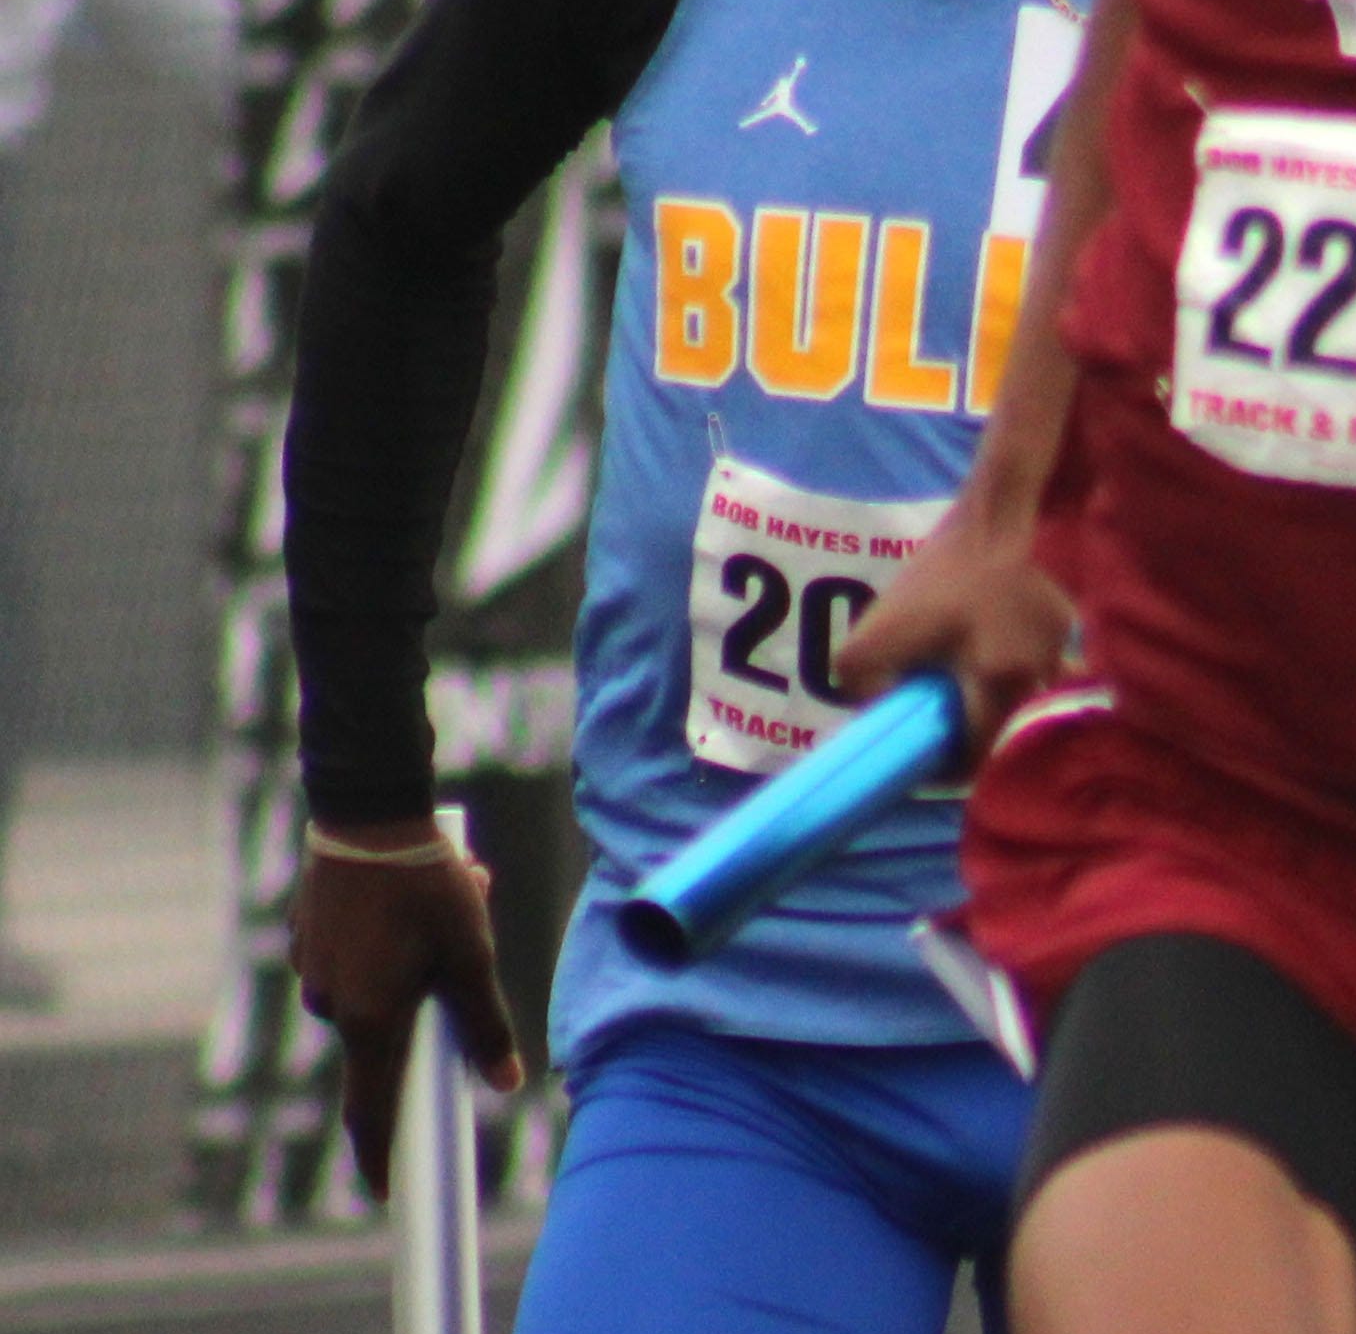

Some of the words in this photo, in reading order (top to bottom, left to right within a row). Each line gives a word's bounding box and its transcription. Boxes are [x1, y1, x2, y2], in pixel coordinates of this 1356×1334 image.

[1188, 388, 1299, 438] TRACK
[1309, 409, 1336, 442] &
[711, 492, 760, 534] BOB
[766, 515, 862, 556] HAYES
[706, 694, 818, 752] TRACK
